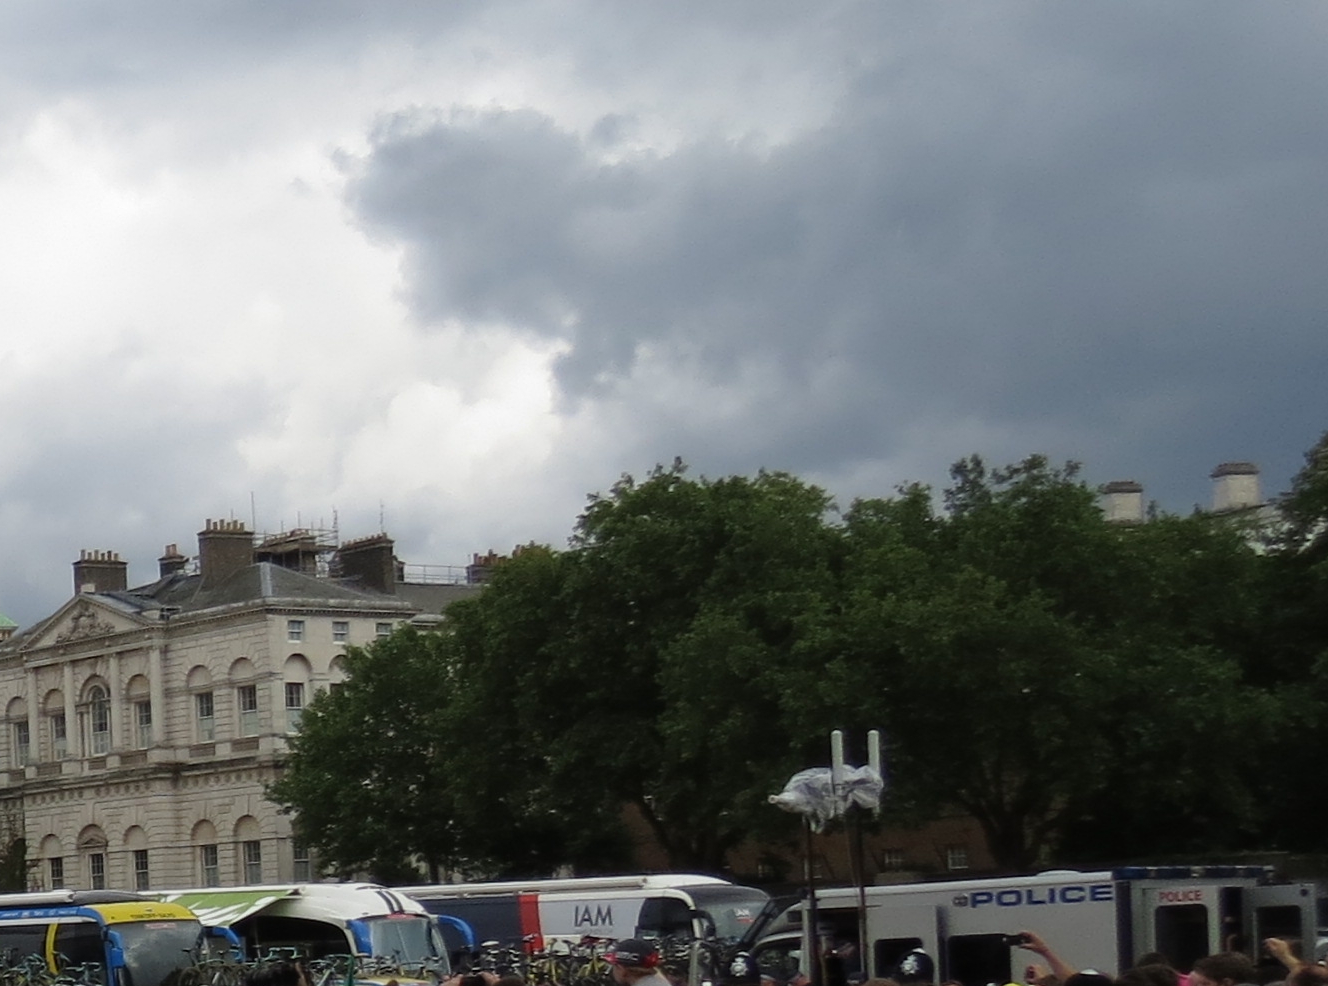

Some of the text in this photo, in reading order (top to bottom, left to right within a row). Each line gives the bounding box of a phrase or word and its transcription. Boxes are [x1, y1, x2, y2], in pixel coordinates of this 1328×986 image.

[970, 884, 1114, 908] POLICE
[1158, 890, 1203, 902] POLICE
[574, 904, 613, 927] IAM
